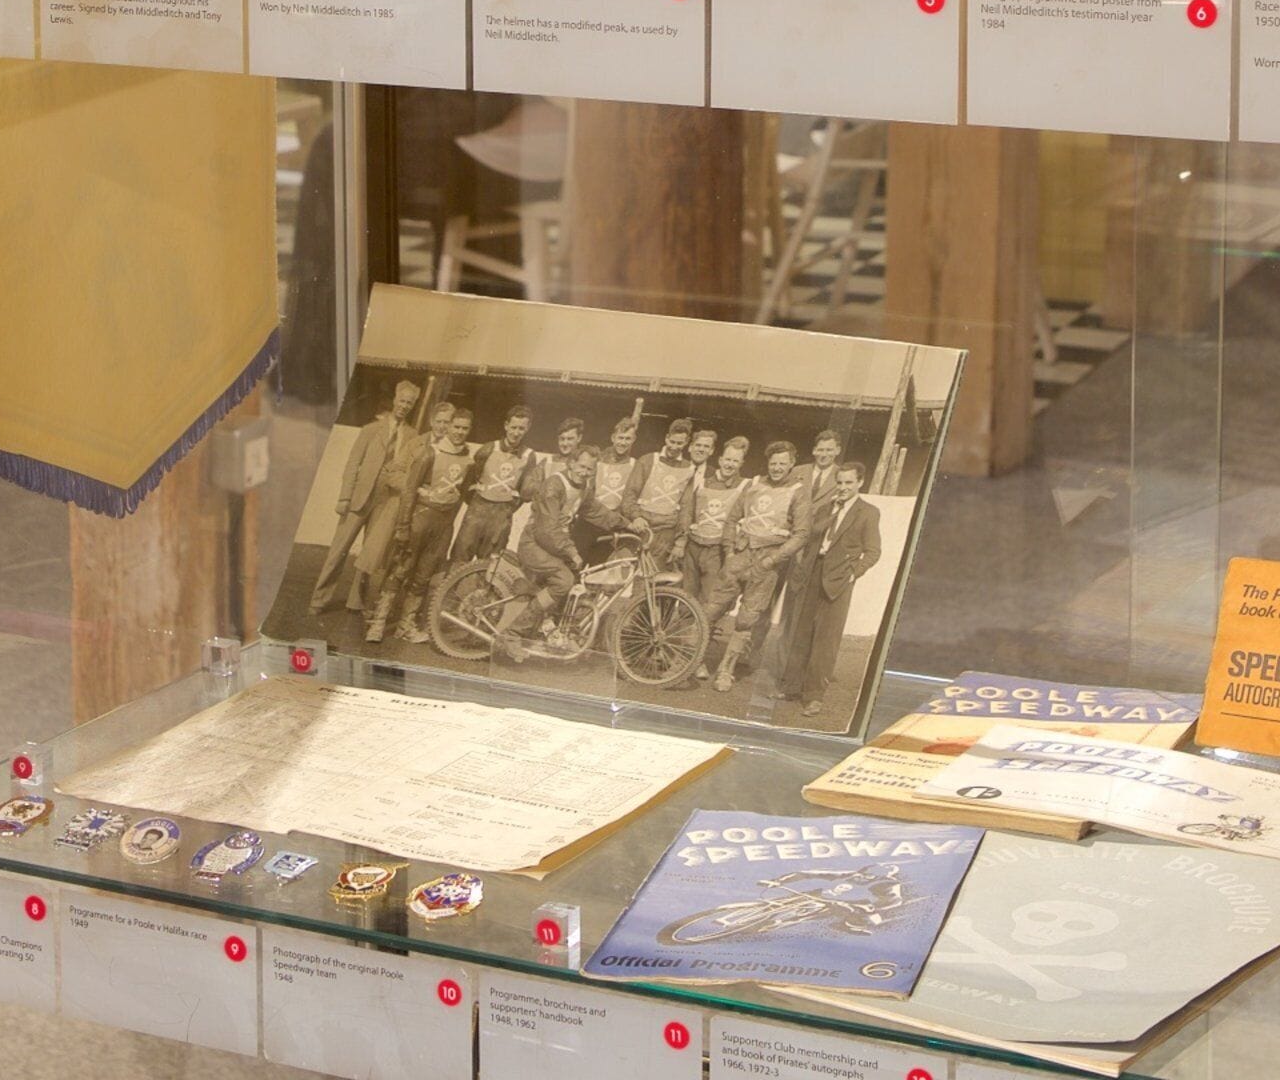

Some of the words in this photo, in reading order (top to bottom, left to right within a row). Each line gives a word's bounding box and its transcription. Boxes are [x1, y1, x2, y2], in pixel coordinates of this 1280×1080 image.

[259, 1, 278, 13] Won
[279, 2, 292, 16] by
[292, 3, 310, 14] Neil
[310, 4, 361, 17] Middleditch
[362, 6, 372, 17] in
[372, 7, 395, 19] 1985
[980, 3, 1000, 16] Neil
[1001, 4, 1069, 19] Middleditch's
[1070, 7, 1123, 22] testimonial
[1124, 12, 1154, 26] year
[1196, 7, 1207, 21] 6
[1254, 1, 1278, 14] Race
[980, 18, 1006, 31] 1984
[1242, 584, 1268, 601] The
[1238, 602, 1276, 619] book
[942, 685, 1101, 704] POOLE
[928, 697, 1182, 722] SPEEDWAY
[1008, 740, 1165, 765] POOLE
[996, 757, 1243, 804] SPEEDWAY
[685, 823, 865, 845] POOLE
[676, 838, 960, 867] SPEEDWAY
[69, 905, 115, 925] Programme
[115, 914, 126, 926] for
[133, 917, 156, 931] Poole
[162, 923, 189, 938] Halifax
[190, 930, 208, 941] race
[69, 918, 89, 930] 1949
[230, 943, 239, 956] 9
[272, 946, 319, 967] Photograph
[319, 954, 330, 967] of
[331, 957, 346, 970] the
[347, 960, 379, 978] original
[379, 966, 405, 981] Poole
[272, 958, 315, 978] Speedway
[315, 966, 338, 980] team
[599, 954, 681, 971] Official
[689, 958, 840, 978] Programme
[273, 972, 294, 985] 1948
[442, 986, 457, 1000] 10
[721, 1030, 772, 1052] Supporters
[773, 1040, 796, 1054] Club
[796, 1044, 856, 1067] membership
[858, 1055, 879, 1069] card
[721, 1044, 740, 1057] and
[740, 1047, 764, 1061] book
[766, 1052, 776, 1063] of
[777, 1054, 810, 1070] Pirates'
[811, 1060, 865, 1080] autographs
[721, 1057, 747, 1072] 1966,
[748, 1062, 780, 1077] 1972-3
